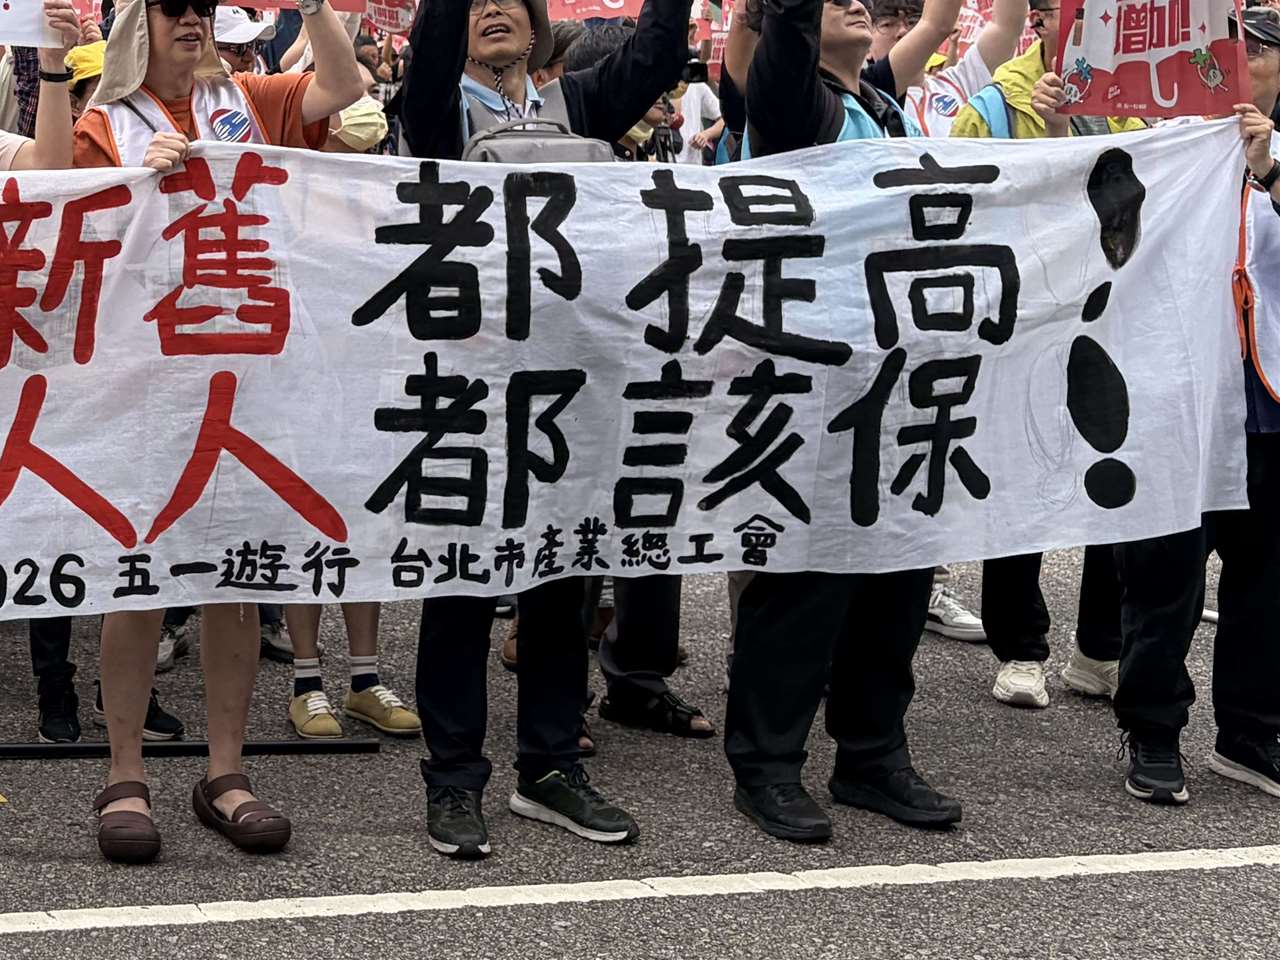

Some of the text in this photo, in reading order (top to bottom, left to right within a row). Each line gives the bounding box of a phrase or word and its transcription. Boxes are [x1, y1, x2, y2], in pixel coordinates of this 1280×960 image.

[112, 539, 361, 599] 五一遊行
[390, 514, 786, 590] 台北市產業總工會
